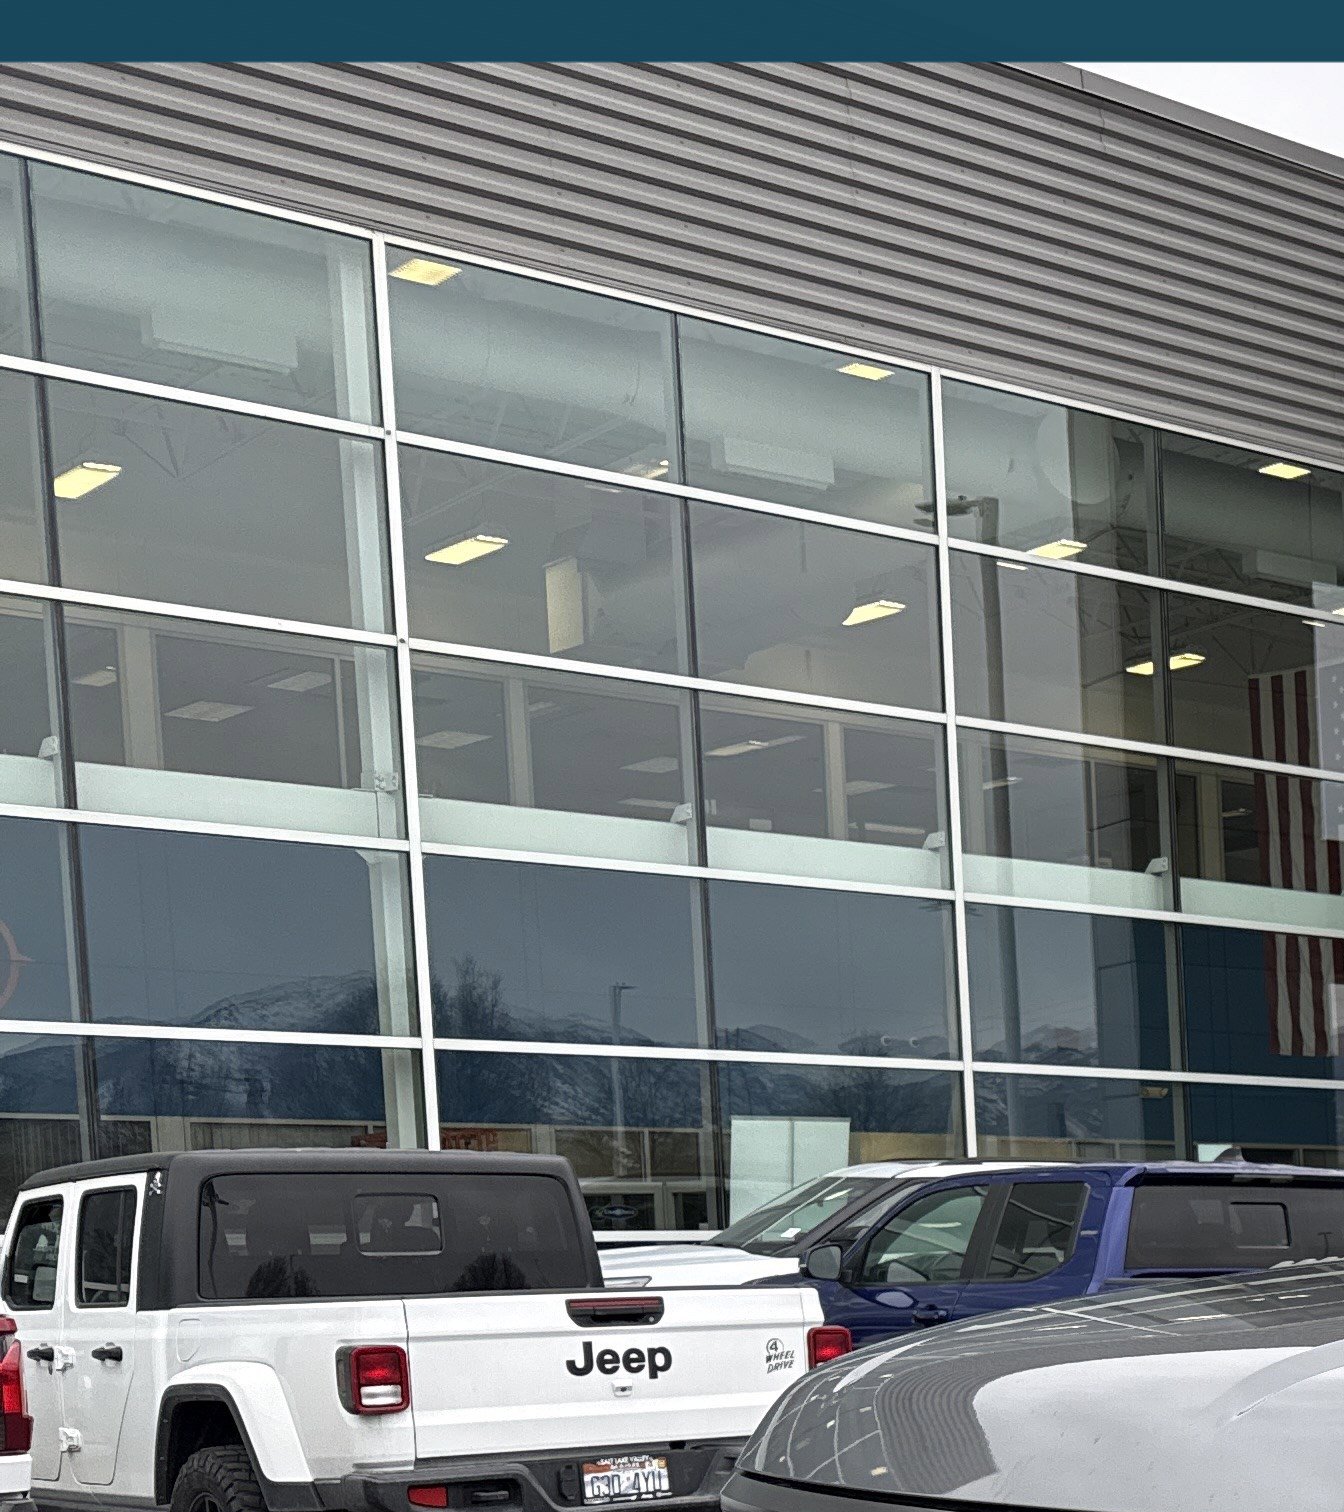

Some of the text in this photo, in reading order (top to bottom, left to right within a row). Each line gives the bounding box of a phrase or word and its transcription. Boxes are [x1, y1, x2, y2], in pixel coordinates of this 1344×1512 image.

[565, 1340, 673, 1380] Jeep
[766, 1350, 795, 1364] WHEEL
[767, 1360, 794, 1374] DRIVE
